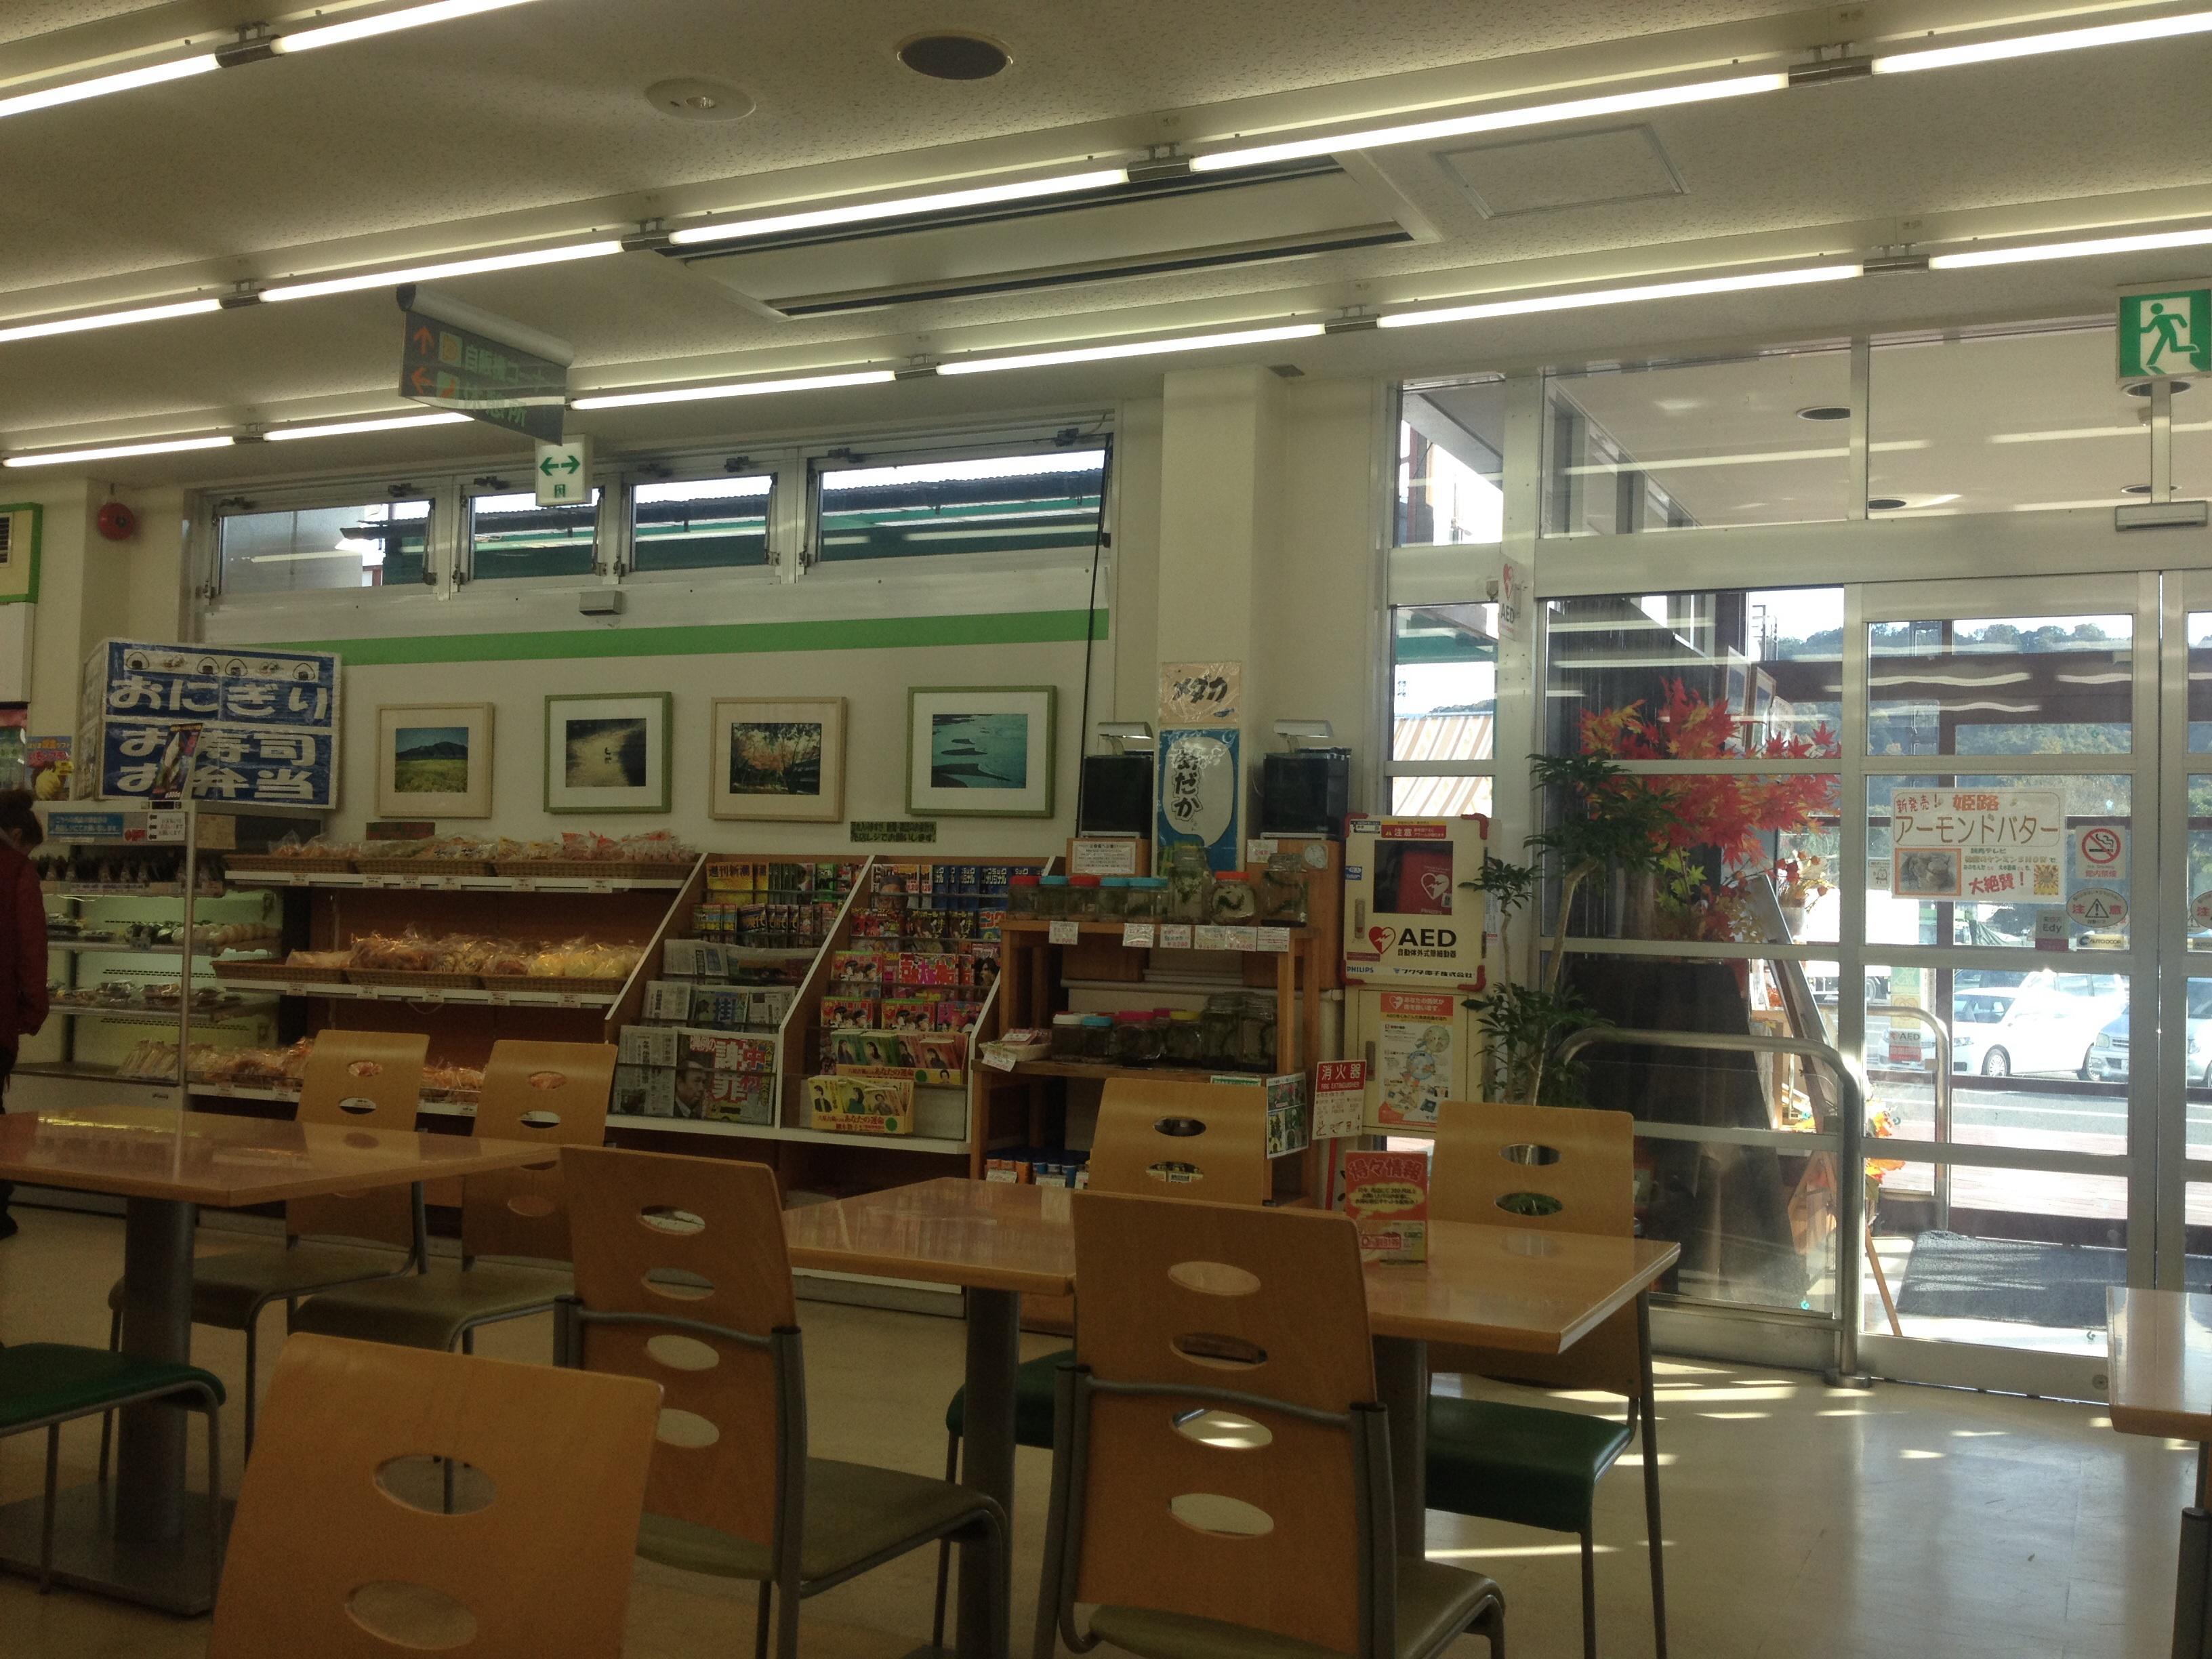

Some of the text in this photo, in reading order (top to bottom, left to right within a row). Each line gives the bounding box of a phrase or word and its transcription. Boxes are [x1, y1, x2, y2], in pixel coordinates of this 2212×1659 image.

[1500, 603, 1515, 624] AED
[108, 675, 328, 720] おにぎり
[1173, 675, 1228, 703] メダカ
[1952, 794, 2000, 811] 姫路
[1394, 827, 1413, 838] 注意
[1895, 815, 2058, 844] アーモンドバター
[2072, 904, 2122, 915] 注 意
[2196, 906, 2211, 917] 注
[1397, 928, 1457, 947] AED
[2043, 924, 2062, 934] Edy
[1346, 966, 1374, 974] PHILIPS
[1900, 1032, 1921, 1040] AED
[1321, 1063, 1361, 1080] 消火器
[1347, 1157, 1423, 1182] 得々情報
